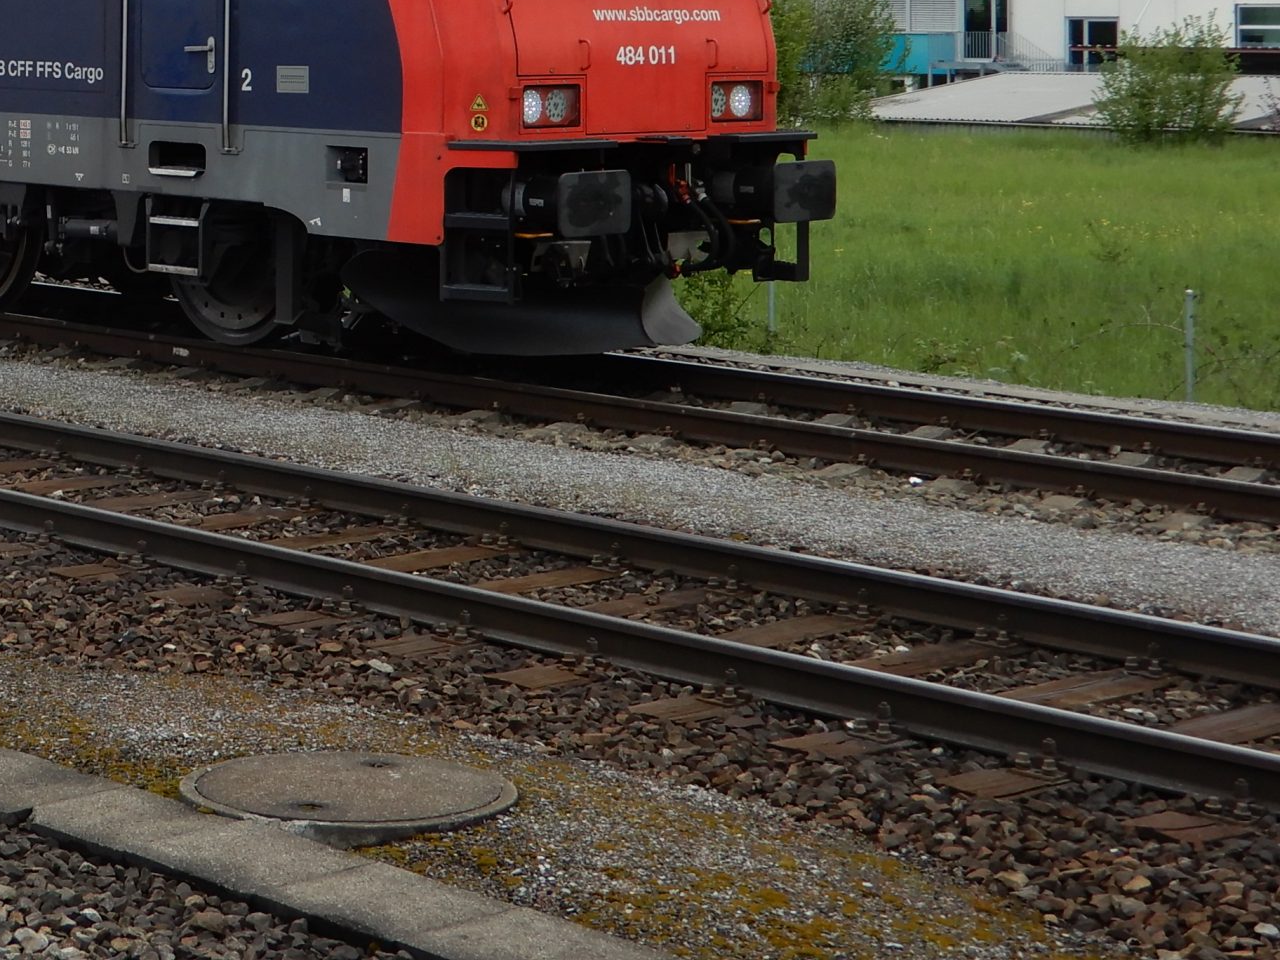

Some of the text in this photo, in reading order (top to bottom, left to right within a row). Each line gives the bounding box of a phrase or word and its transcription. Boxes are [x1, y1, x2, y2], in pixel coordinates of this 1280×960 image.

[592, 5, 721, 25] www.sbbcargo.com
[615, 45, 676, 66] 484 011
[8, 59, 34, 78] CFF
[36, 60, 62, 79] FFS
[64, 62, 105, 84] Cargo
[241, 67, 253, 92] 2
